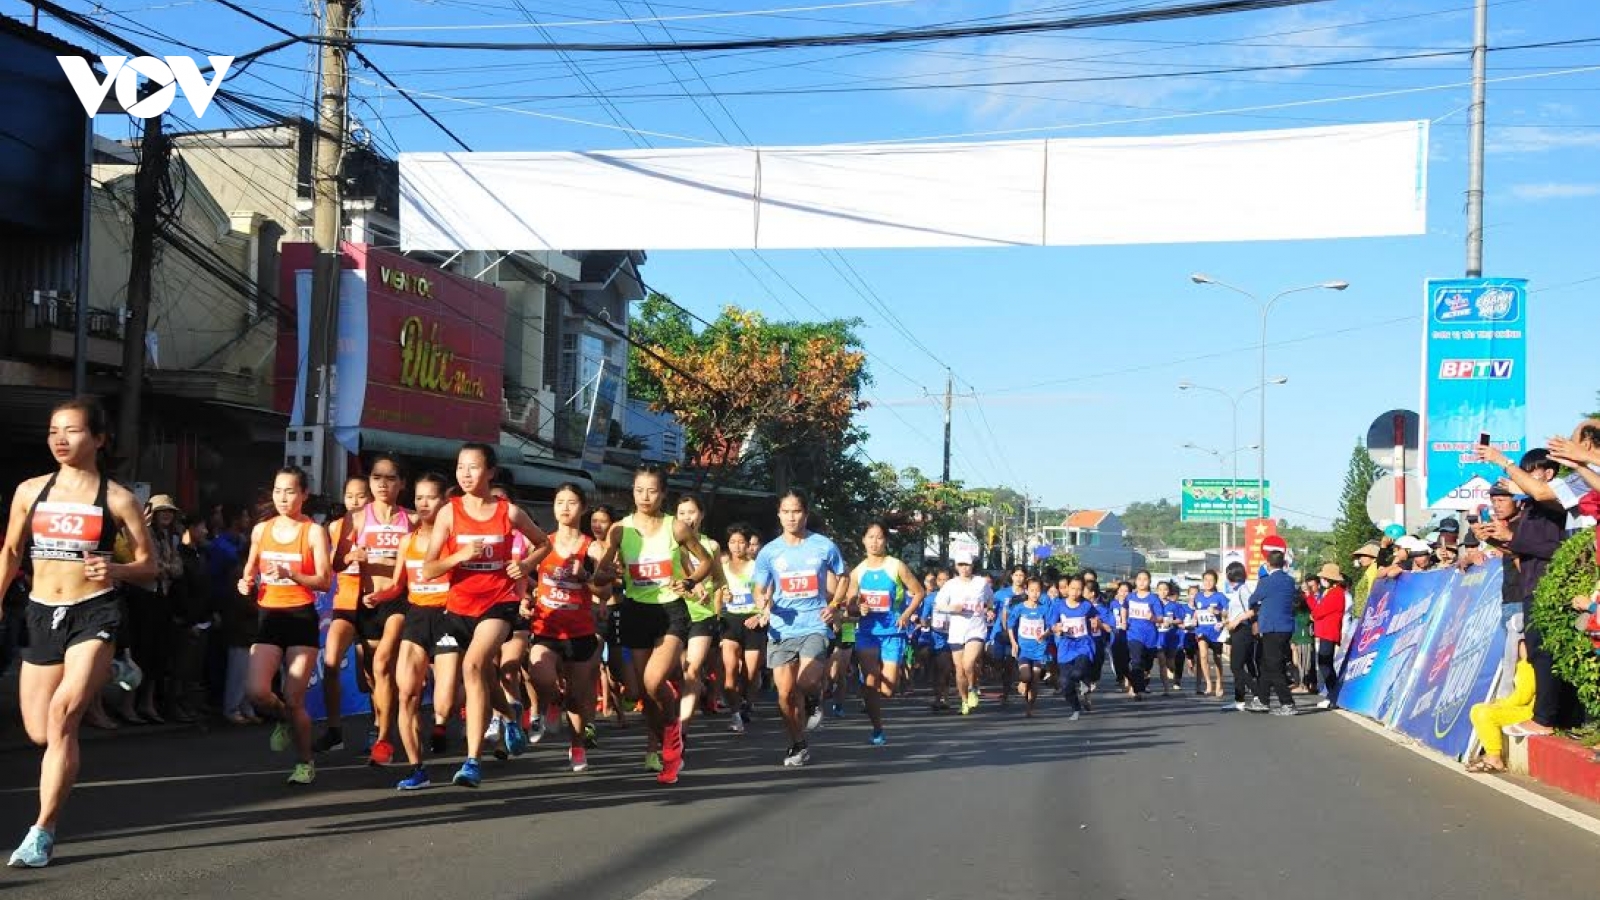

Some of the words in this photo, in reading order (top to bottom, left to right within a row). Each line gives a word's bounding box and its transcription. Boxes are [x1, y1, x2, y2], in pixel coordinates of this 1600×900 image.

[1442, 361, 1510, 378] BPTV
[48, 515, 84, 535] 562
[376, 533, 399, 546] 556
[639, 564, 661, 577] 573
[788, 578, 809, 590] 579
